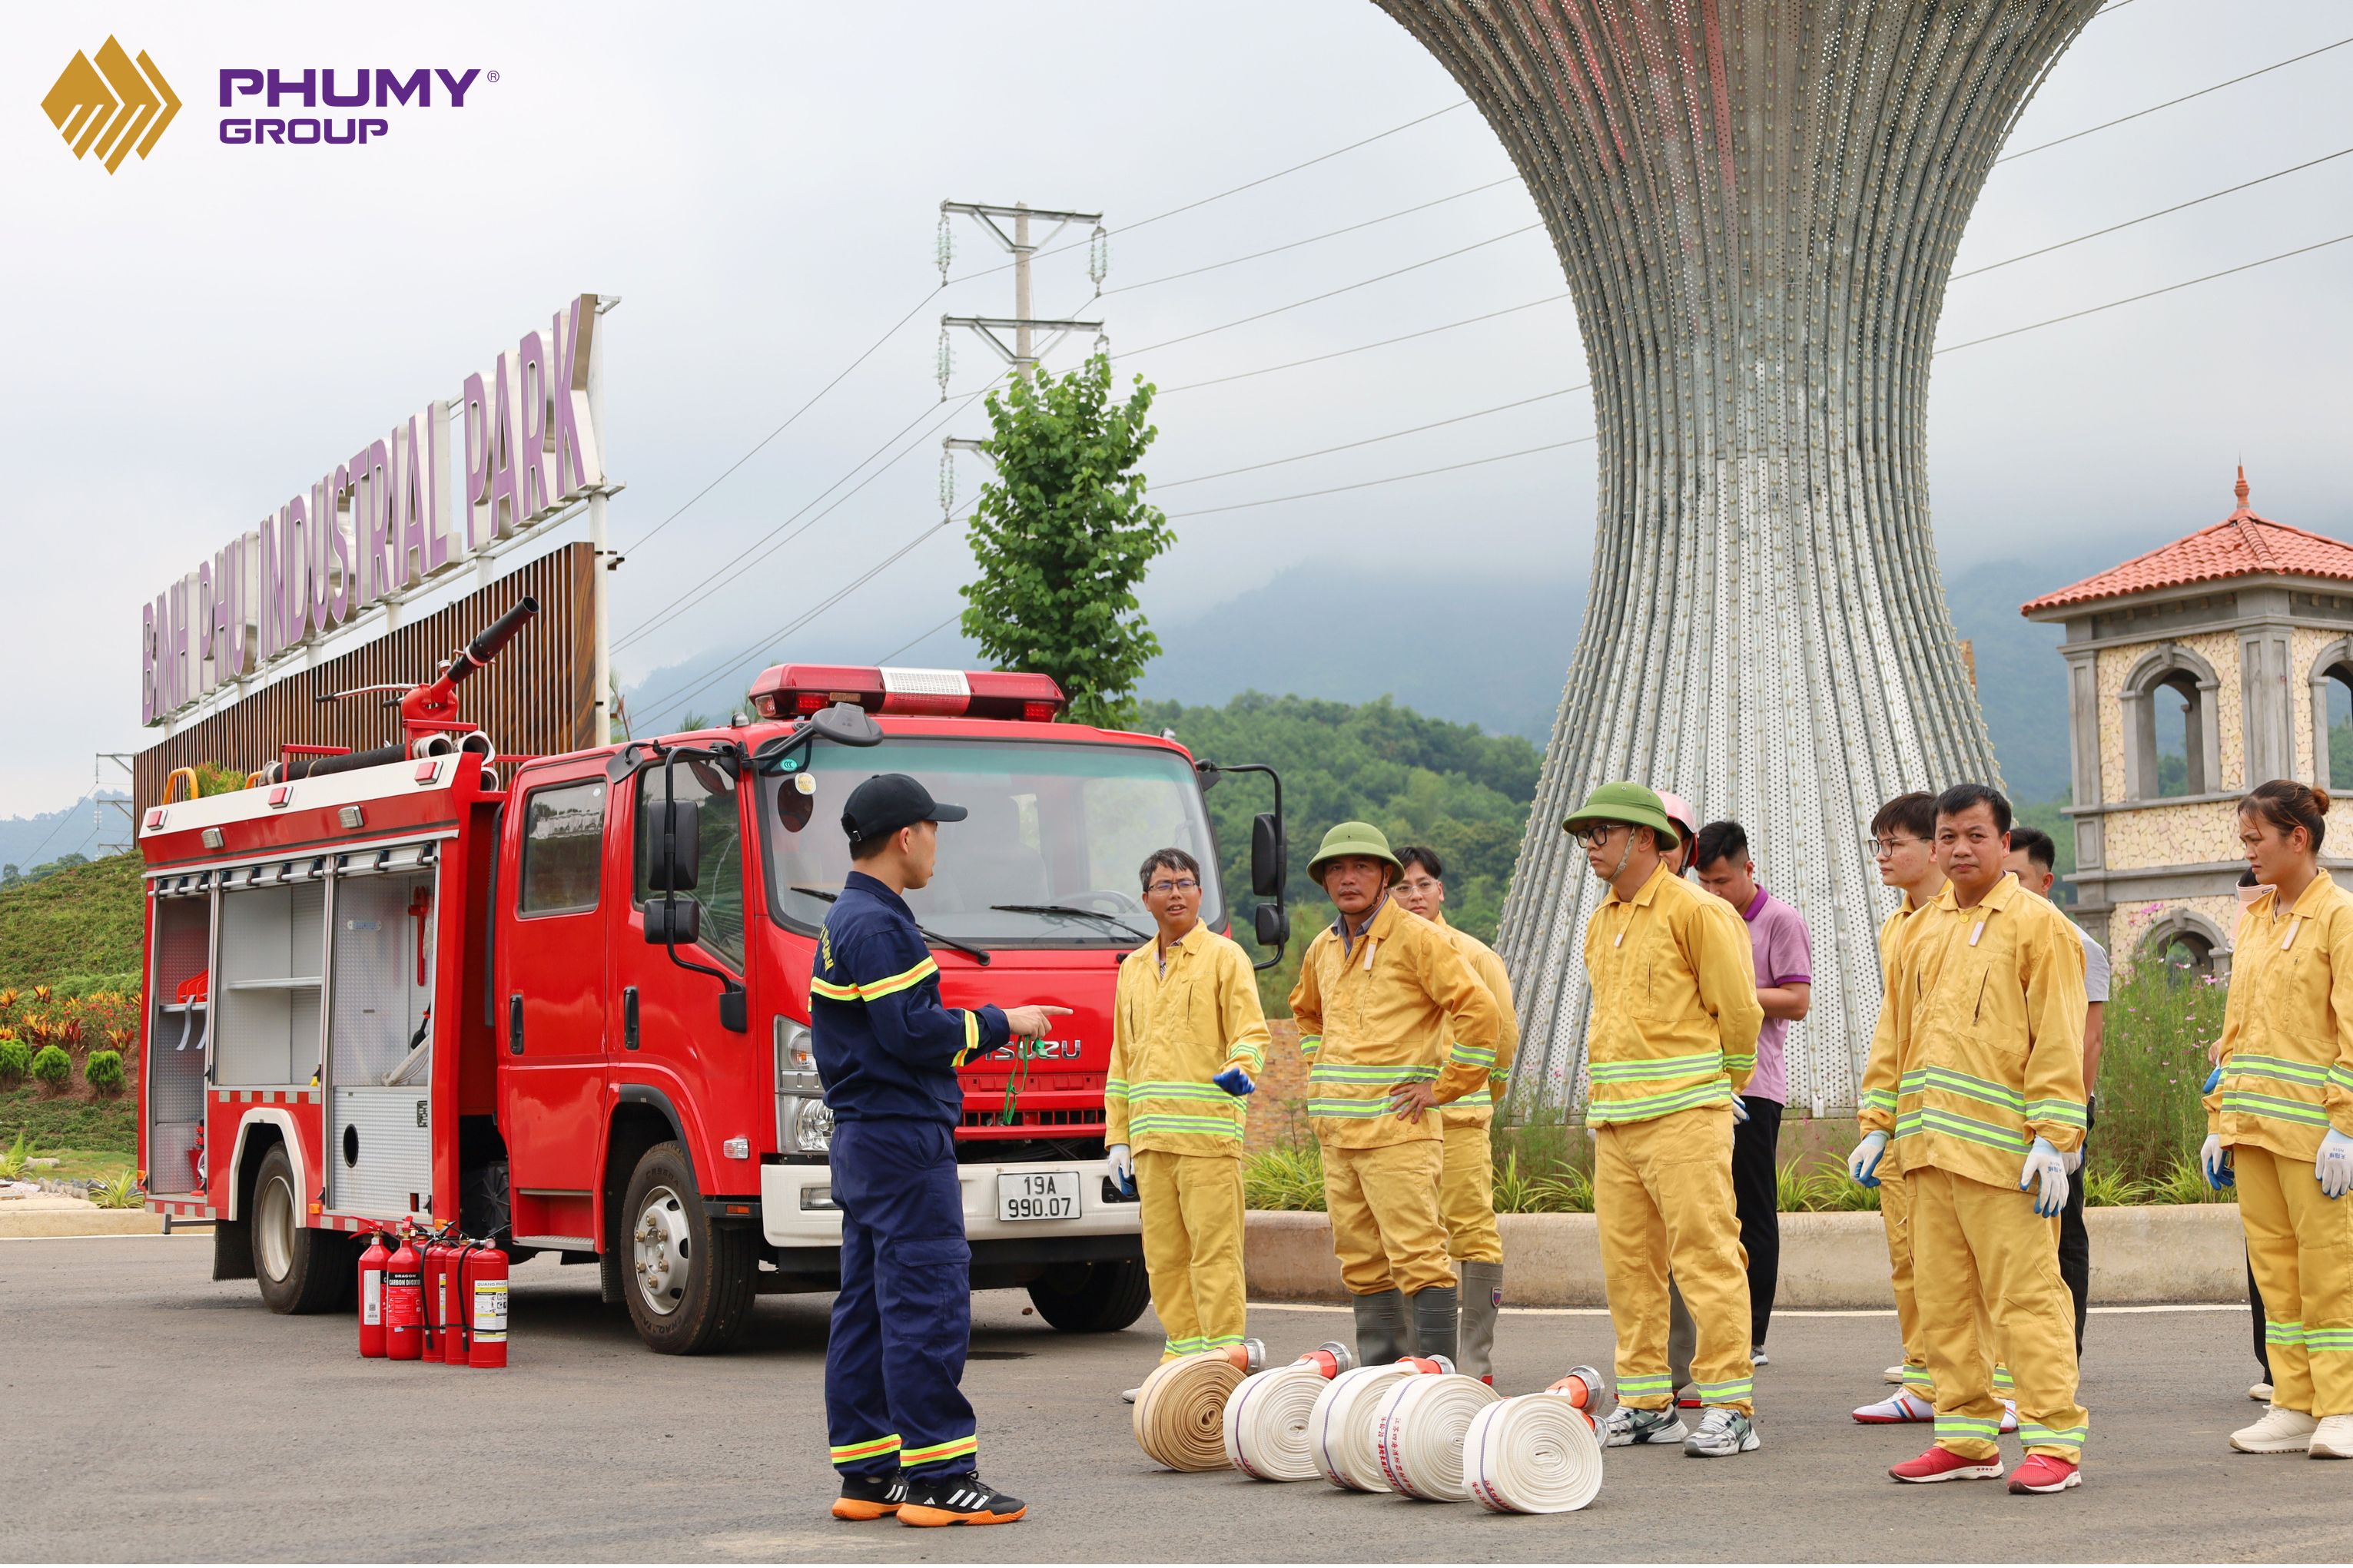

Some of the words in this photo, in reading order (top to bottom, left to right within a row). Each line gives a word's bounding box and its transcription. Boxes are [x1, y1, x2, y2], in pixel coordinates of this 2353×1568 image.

[142, 572, 192, 727] BINH
[200, 532, 252, 695] PHU
[260, 401, 450, 663] INDUSTRIAL
[463, 294, 589, 552] PARK
[1024, 1175, 1057, 1195] 19A
[1008, 1197, 1071, 1218] 990.07
